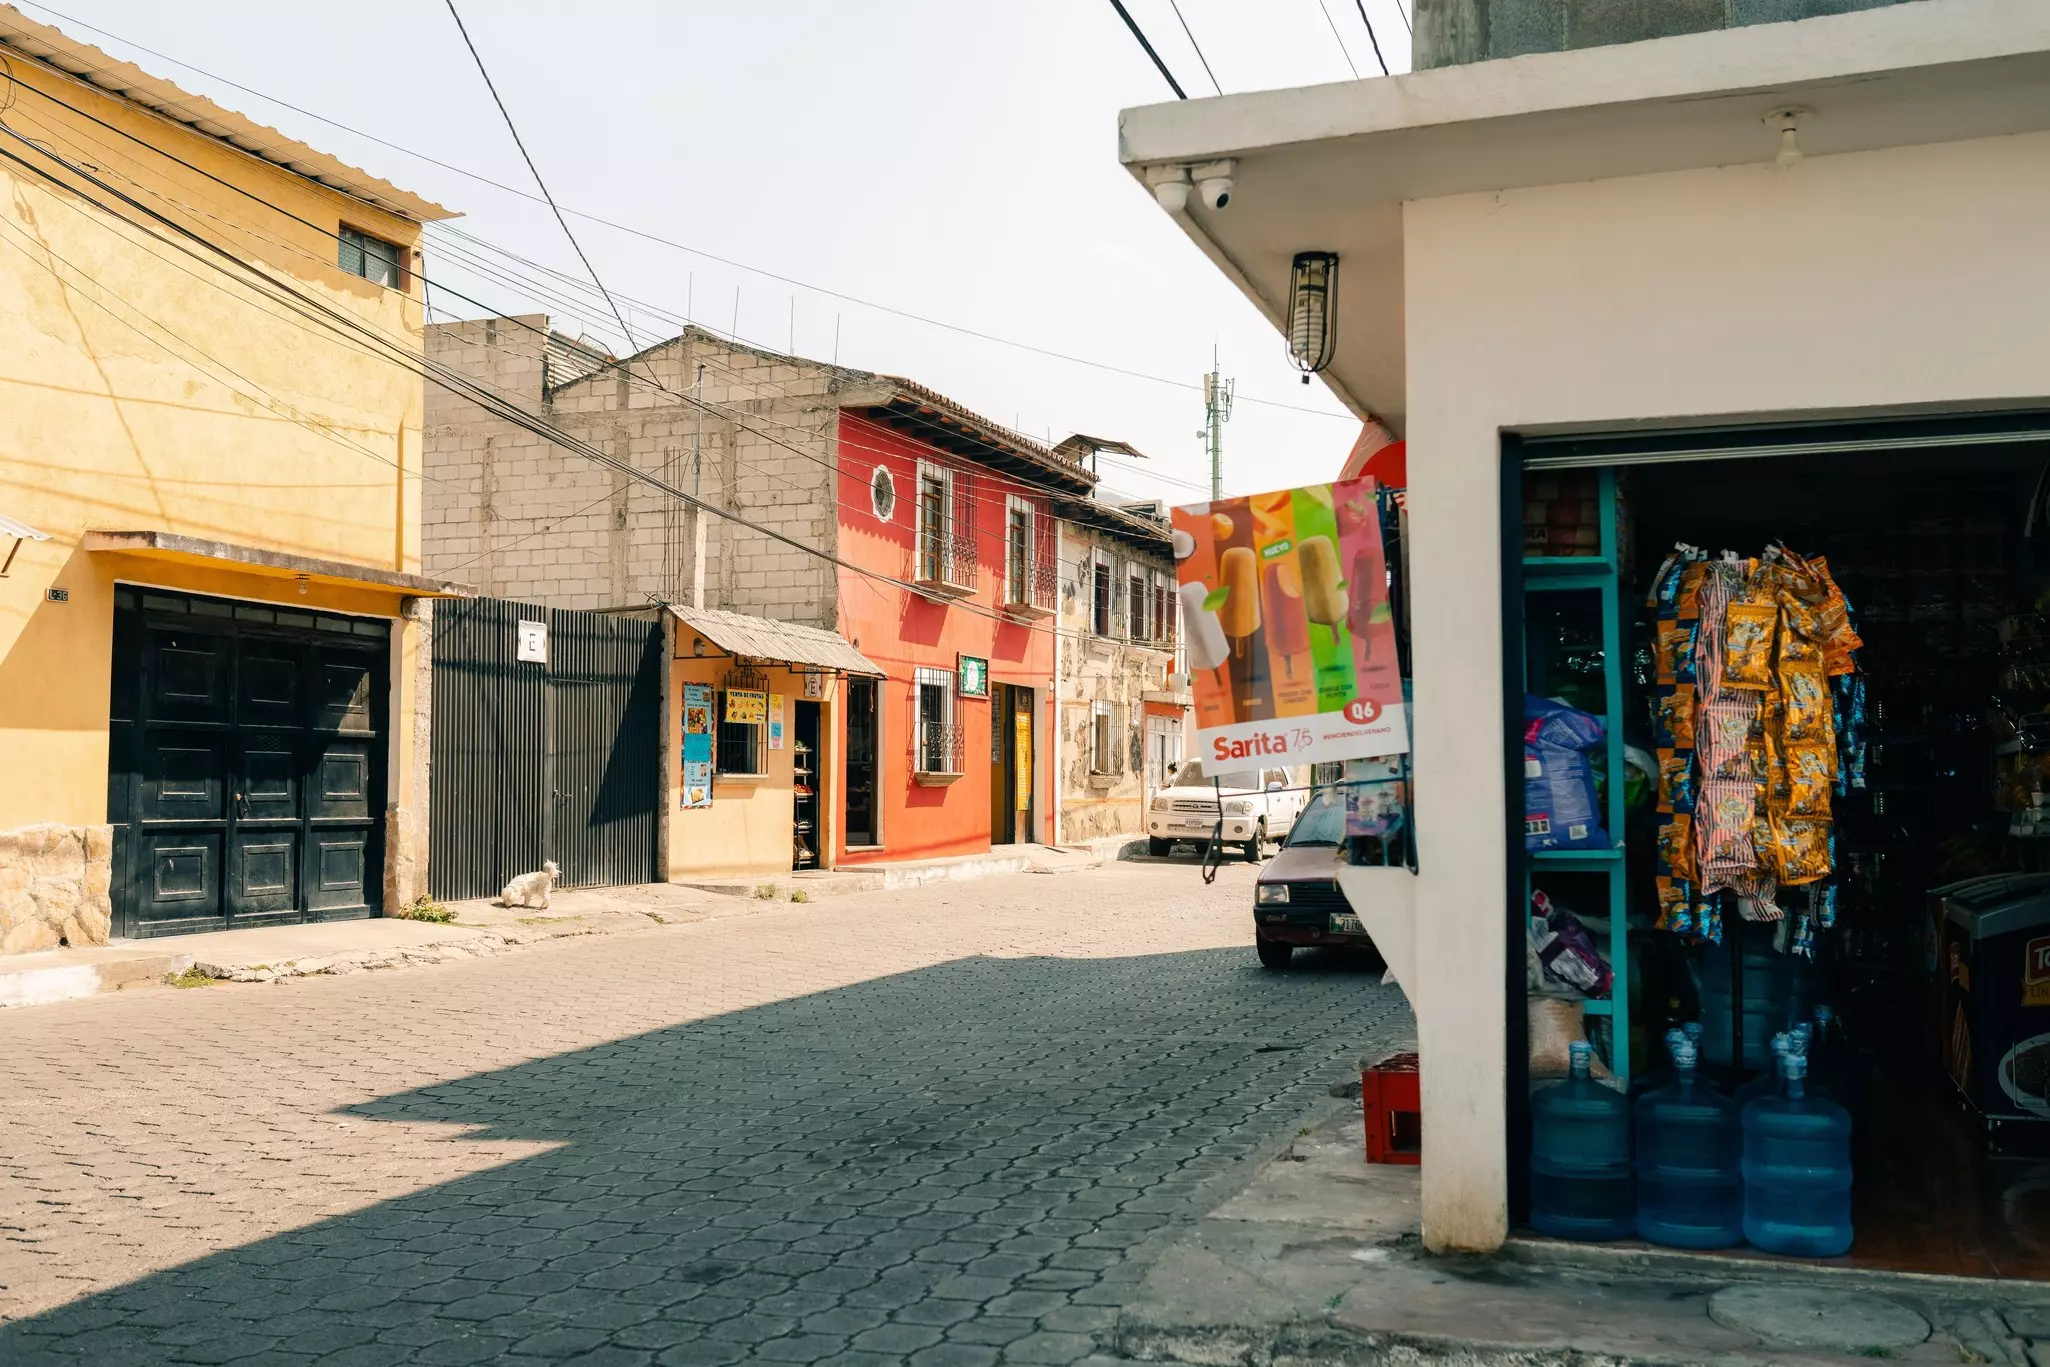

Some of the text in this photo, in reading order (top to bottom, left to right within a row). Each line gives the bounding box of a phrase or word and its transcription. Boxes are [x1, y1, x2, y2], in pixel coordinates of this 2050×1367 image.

[1351, 701, 1375, 720] Q6
[1213, 728, 1313, 761] Sarita 75
